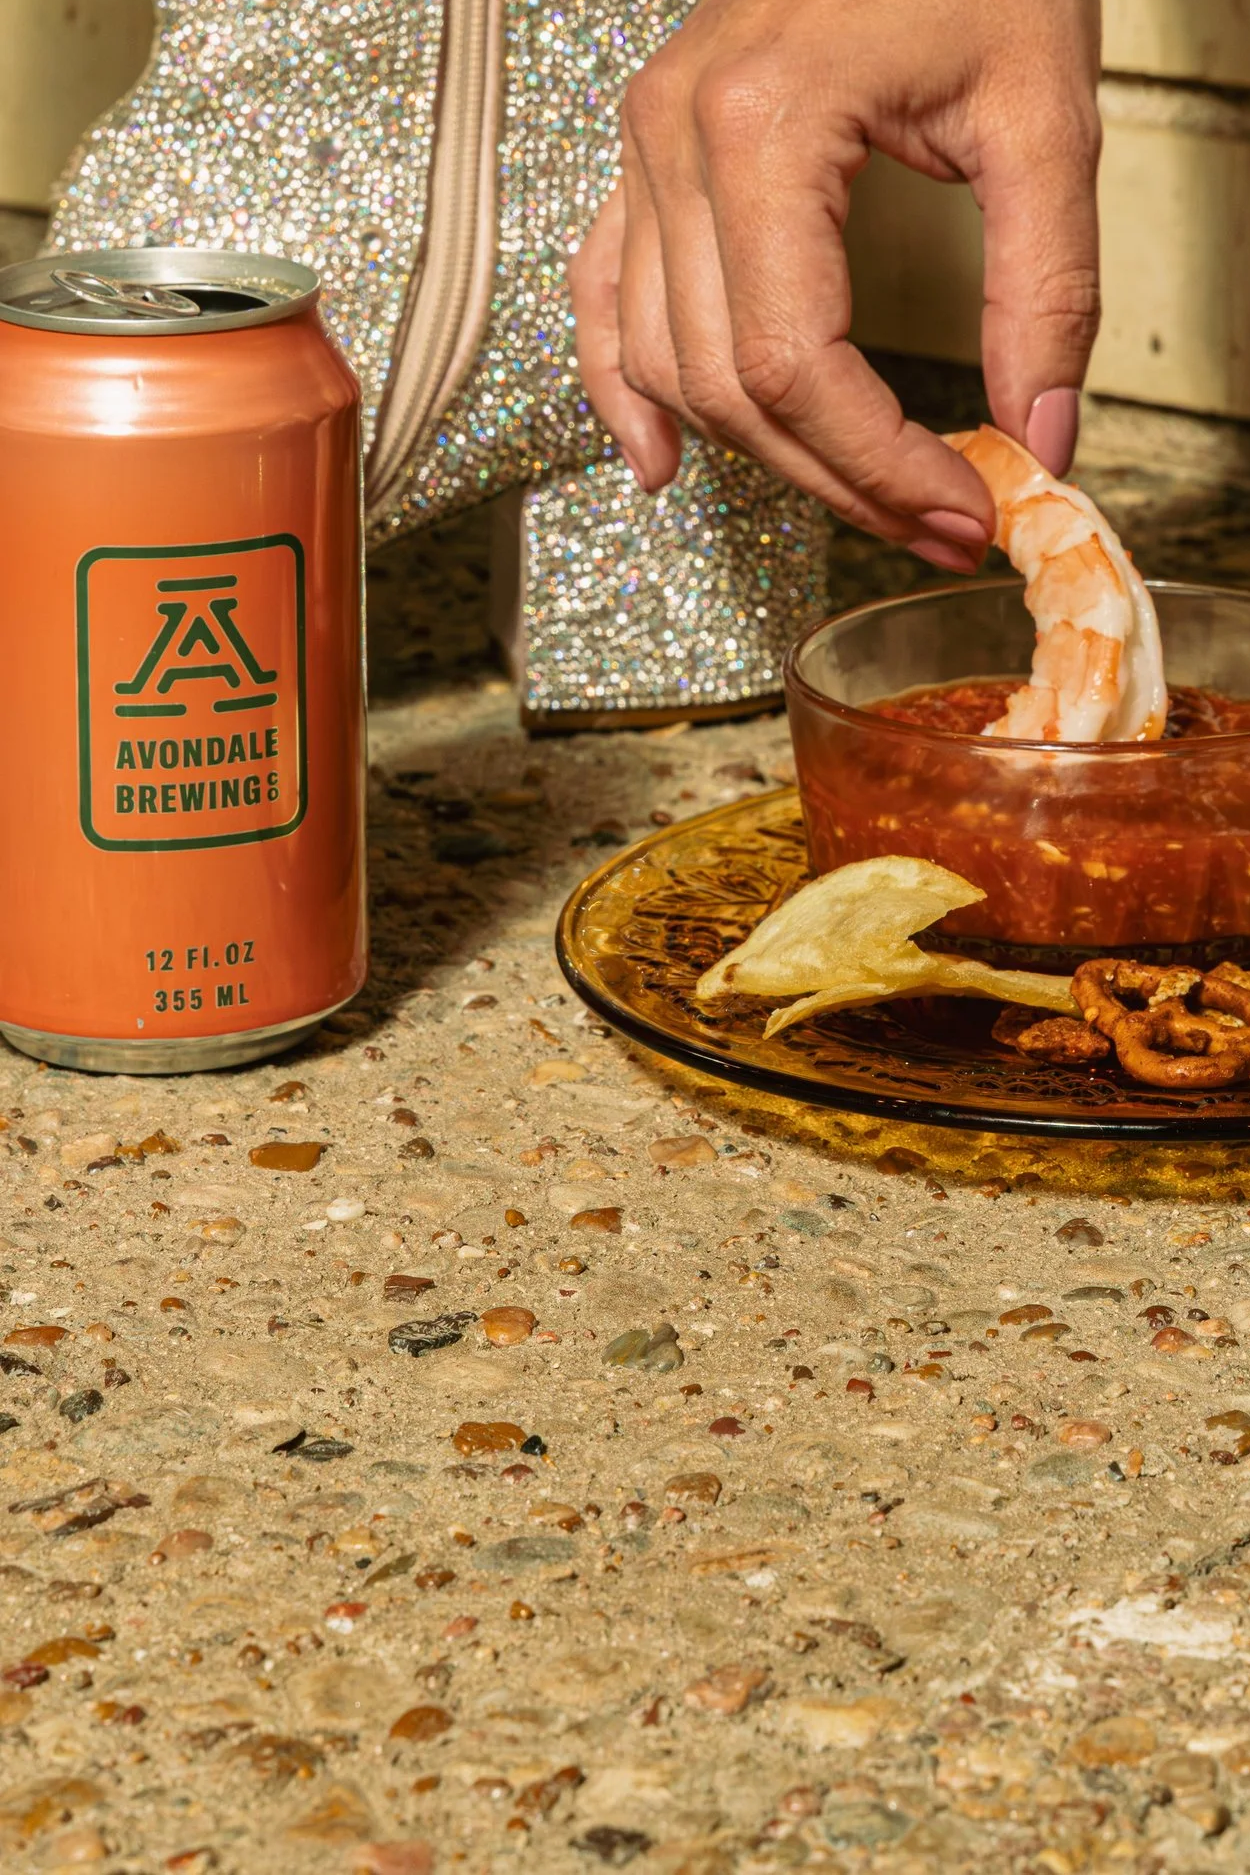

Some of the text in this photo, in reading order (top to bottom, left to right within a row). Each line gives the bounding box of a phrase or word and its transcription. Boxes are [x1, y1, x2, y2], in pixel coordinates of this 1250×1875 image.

[115, 727, 279, 770] AVONDALE
[115, 771, 279, 814] BREWING CO
[145, 949, 174, 972] 12
[154, 982, 250, 1013] 355 ML
